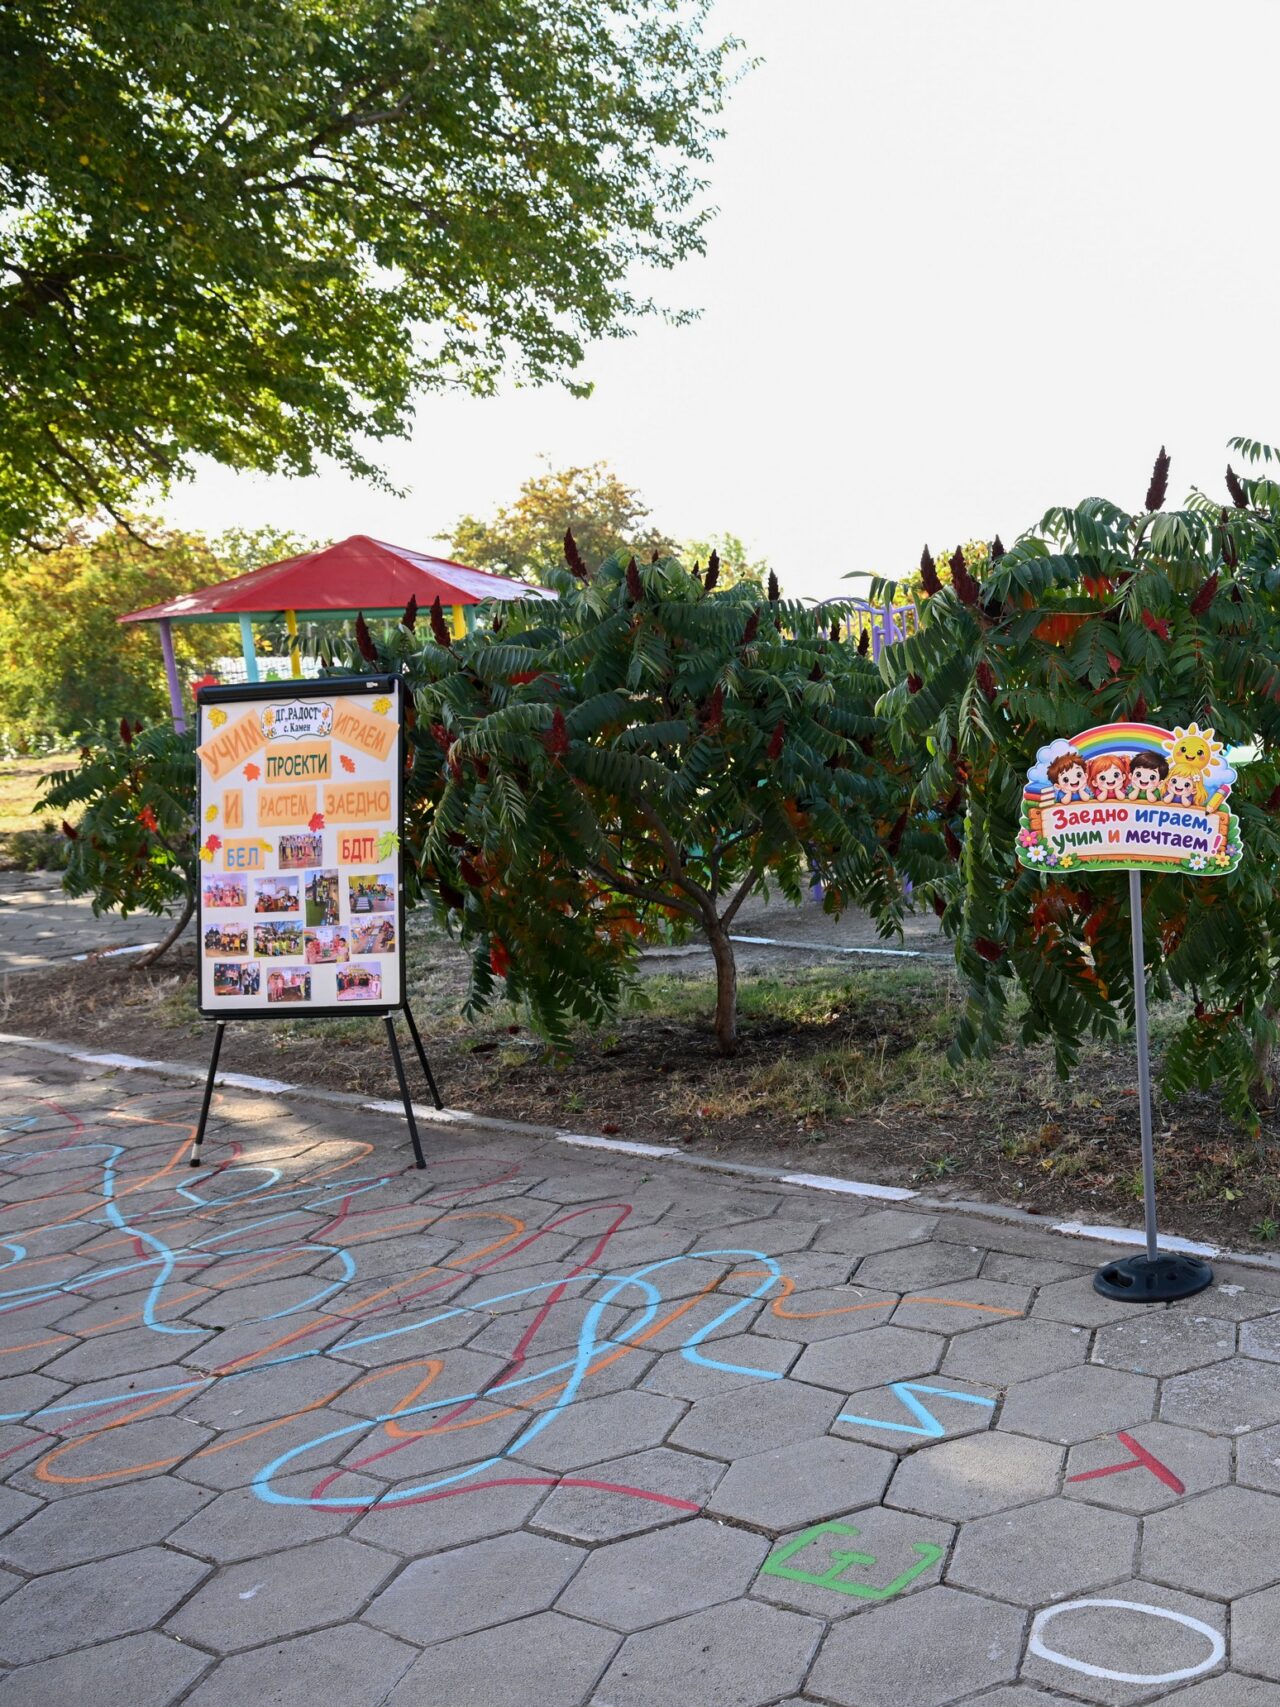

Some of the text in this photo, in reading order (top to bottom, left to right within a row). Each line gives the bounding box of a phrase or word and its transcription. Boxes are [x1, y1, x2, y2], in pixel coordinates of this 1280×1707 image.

[290, 723, 311, 733] Камен
[203, 713, 386, 775] УЧИМ ИГРАЕМ
[266, 753, 328, 777] ПРОЕКТИ
[225, 791, 389, 824] И РАСТЕМ ЗАЕДНО
[1052, 808, 1213, 834] Заедно играем,
[342, 837, 375, 862] БДП
[1052, 830, 1102, 854] учим
[1108, 829, 1120, 843] и
[226, 847, 259, 867] БЕЛ
